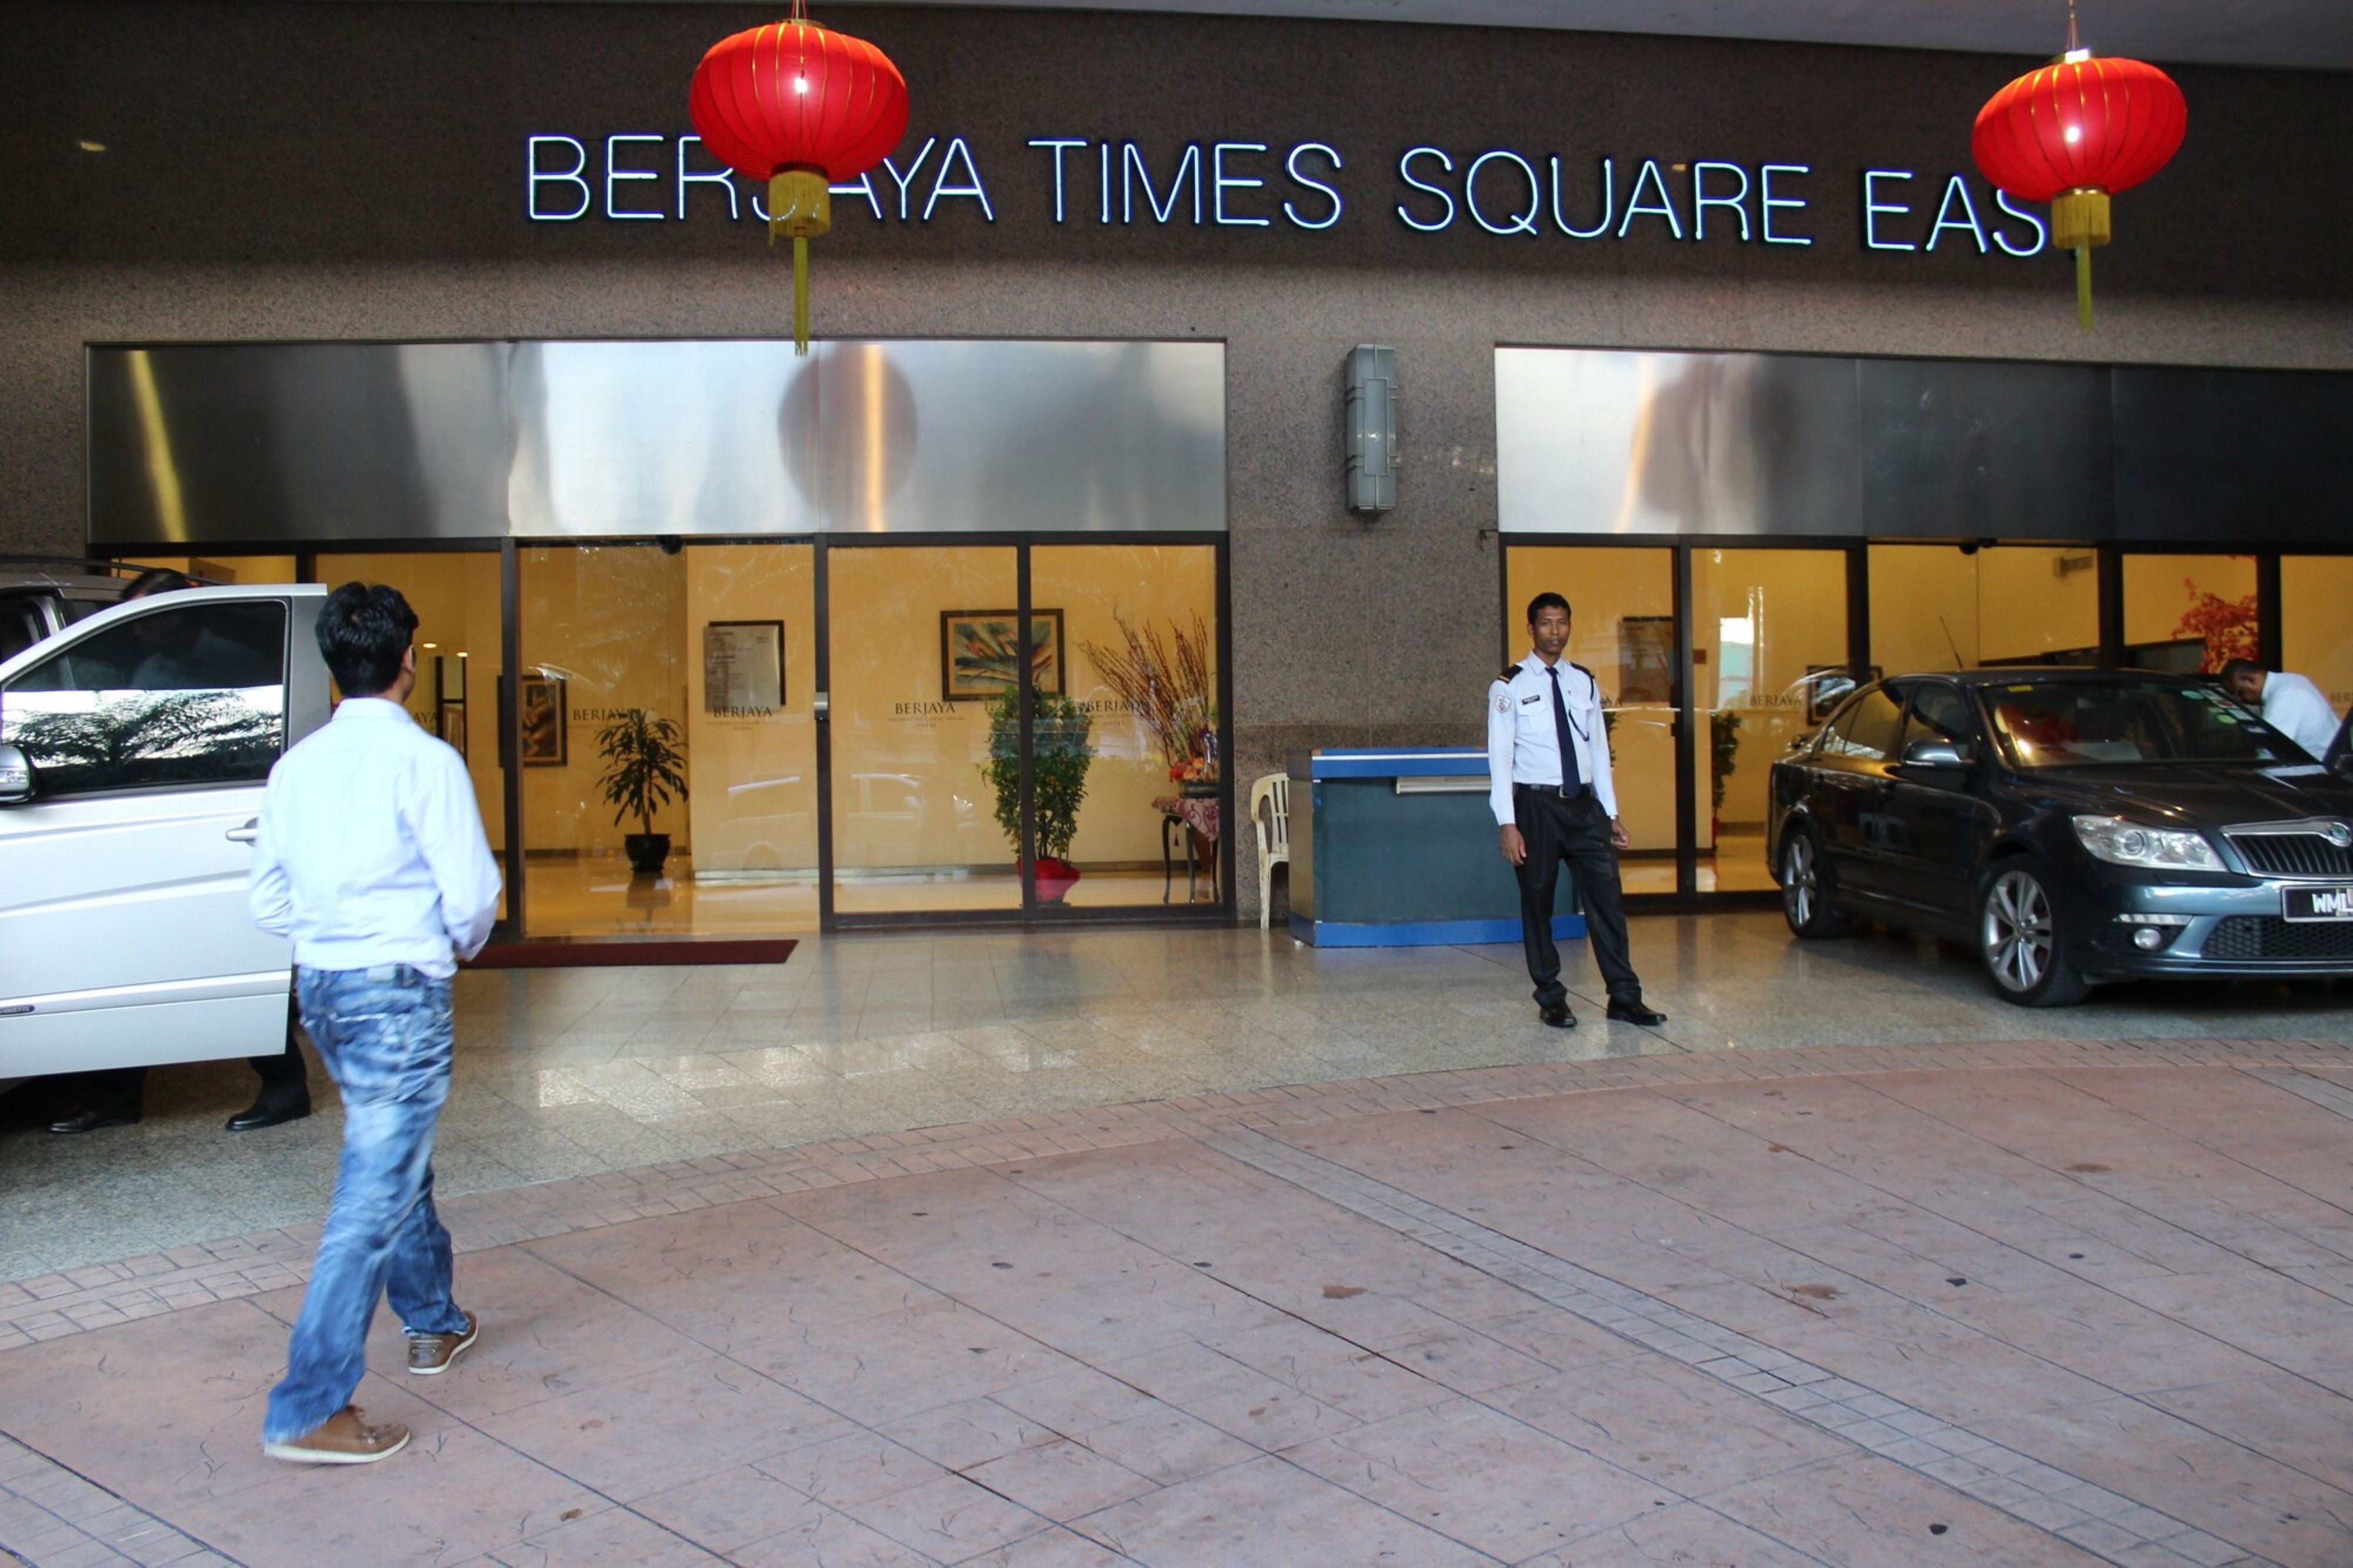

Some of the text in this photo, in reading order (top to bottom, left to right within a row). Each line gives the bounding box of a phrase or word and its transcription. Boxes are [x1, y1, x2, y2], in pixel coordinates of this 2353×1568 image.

[1028, 140, 1342, 229] TIMES
[1398, 147, 1811, 245] SQUARE
[1865, 170, 2082, 256] EAS
[1087, 699, 1144, 713] BERJA
[1749, 695, 1802, 706] BERJAYA
[714, 706, 772, 719] BERJAYA
[895, 702, 955, 715] BERJAYA
